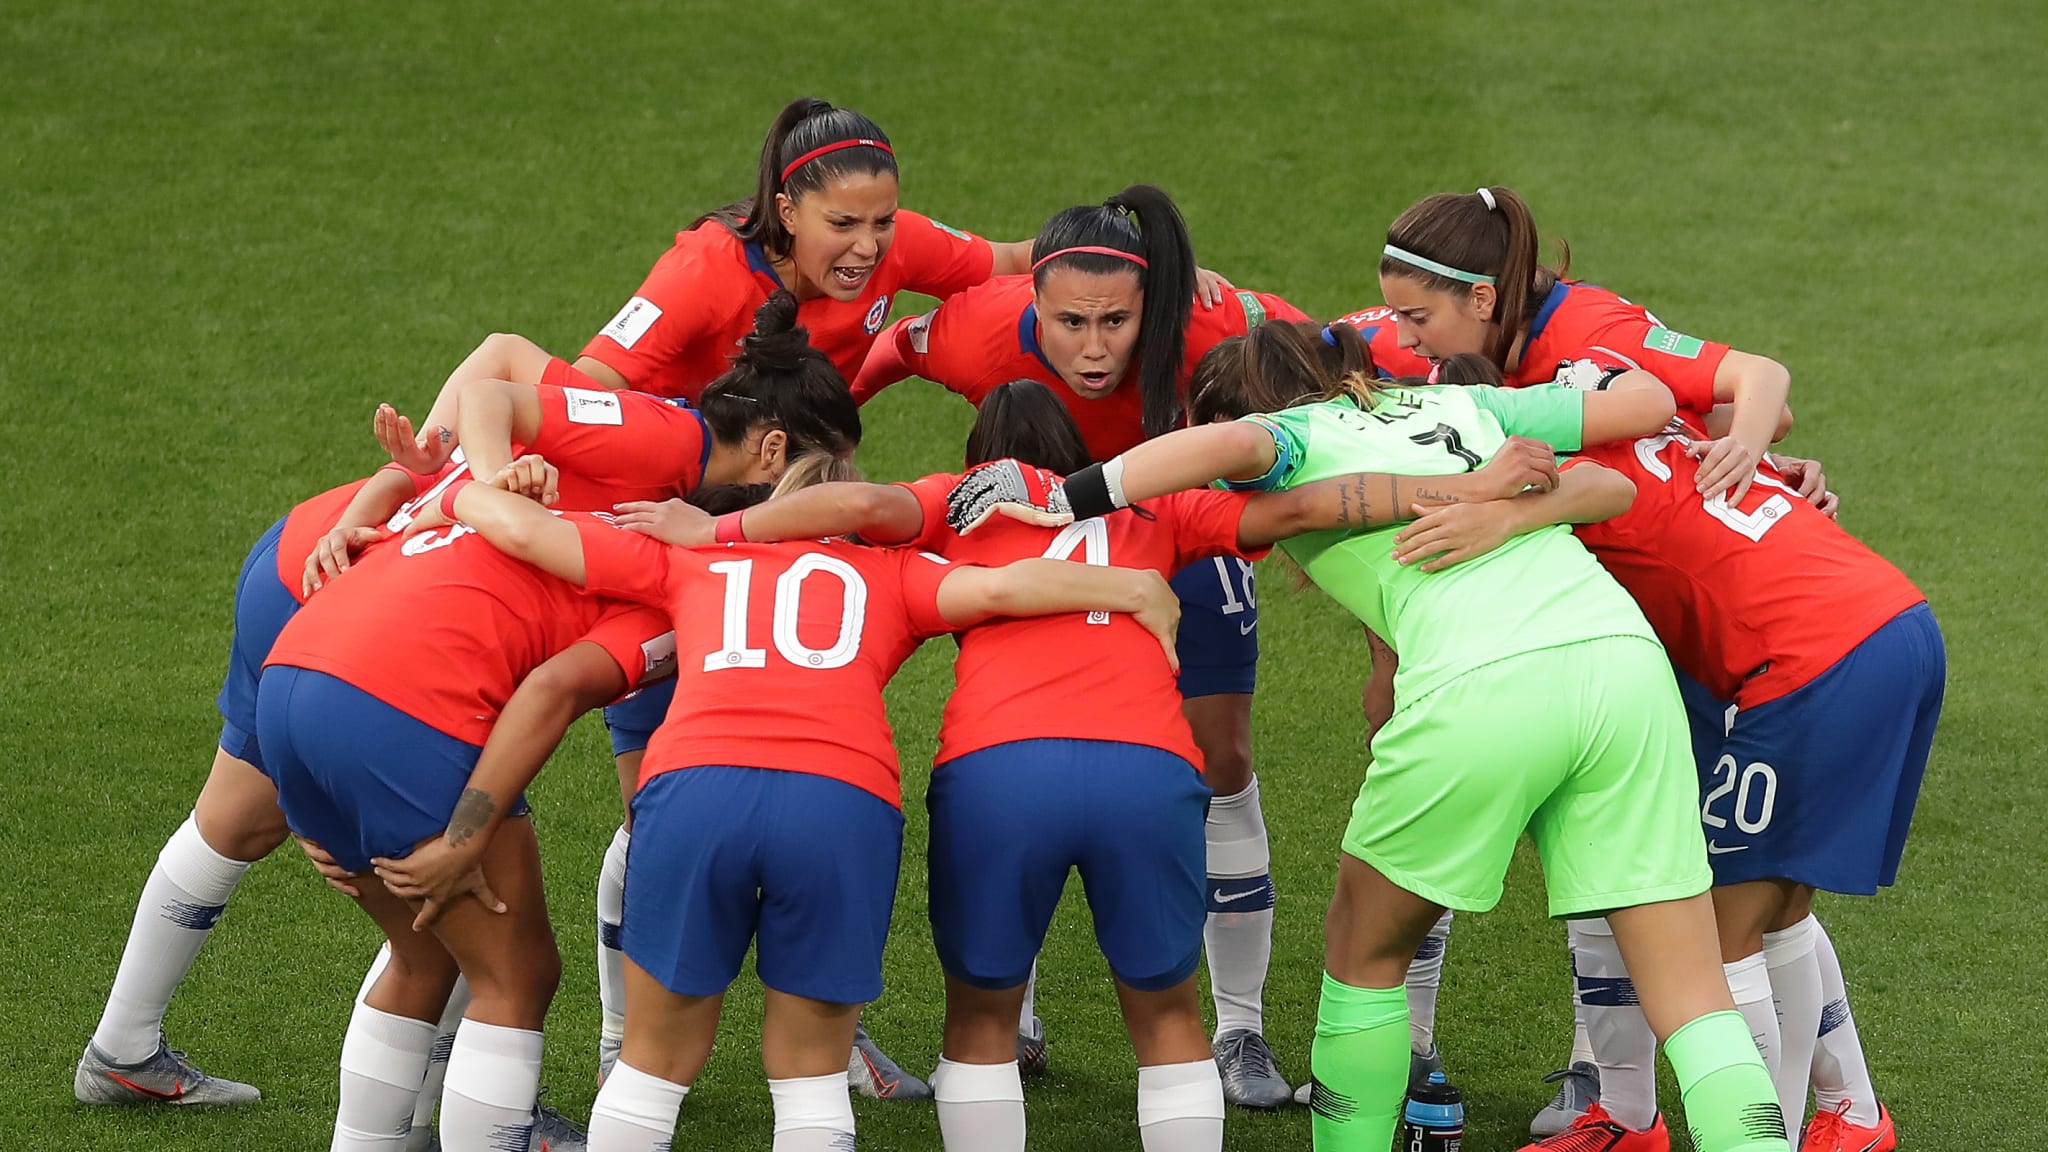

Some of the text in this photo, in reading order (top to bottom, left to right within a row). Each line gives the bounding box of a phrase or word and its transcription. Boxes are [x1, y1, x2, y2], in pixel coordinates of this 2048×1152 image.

[703, 552, 869, 673] 10
[1040, 516, 1110, 625] 4
[1213, 556, 1256, 615] 18
[1701, 753, 1778, 834] 20
